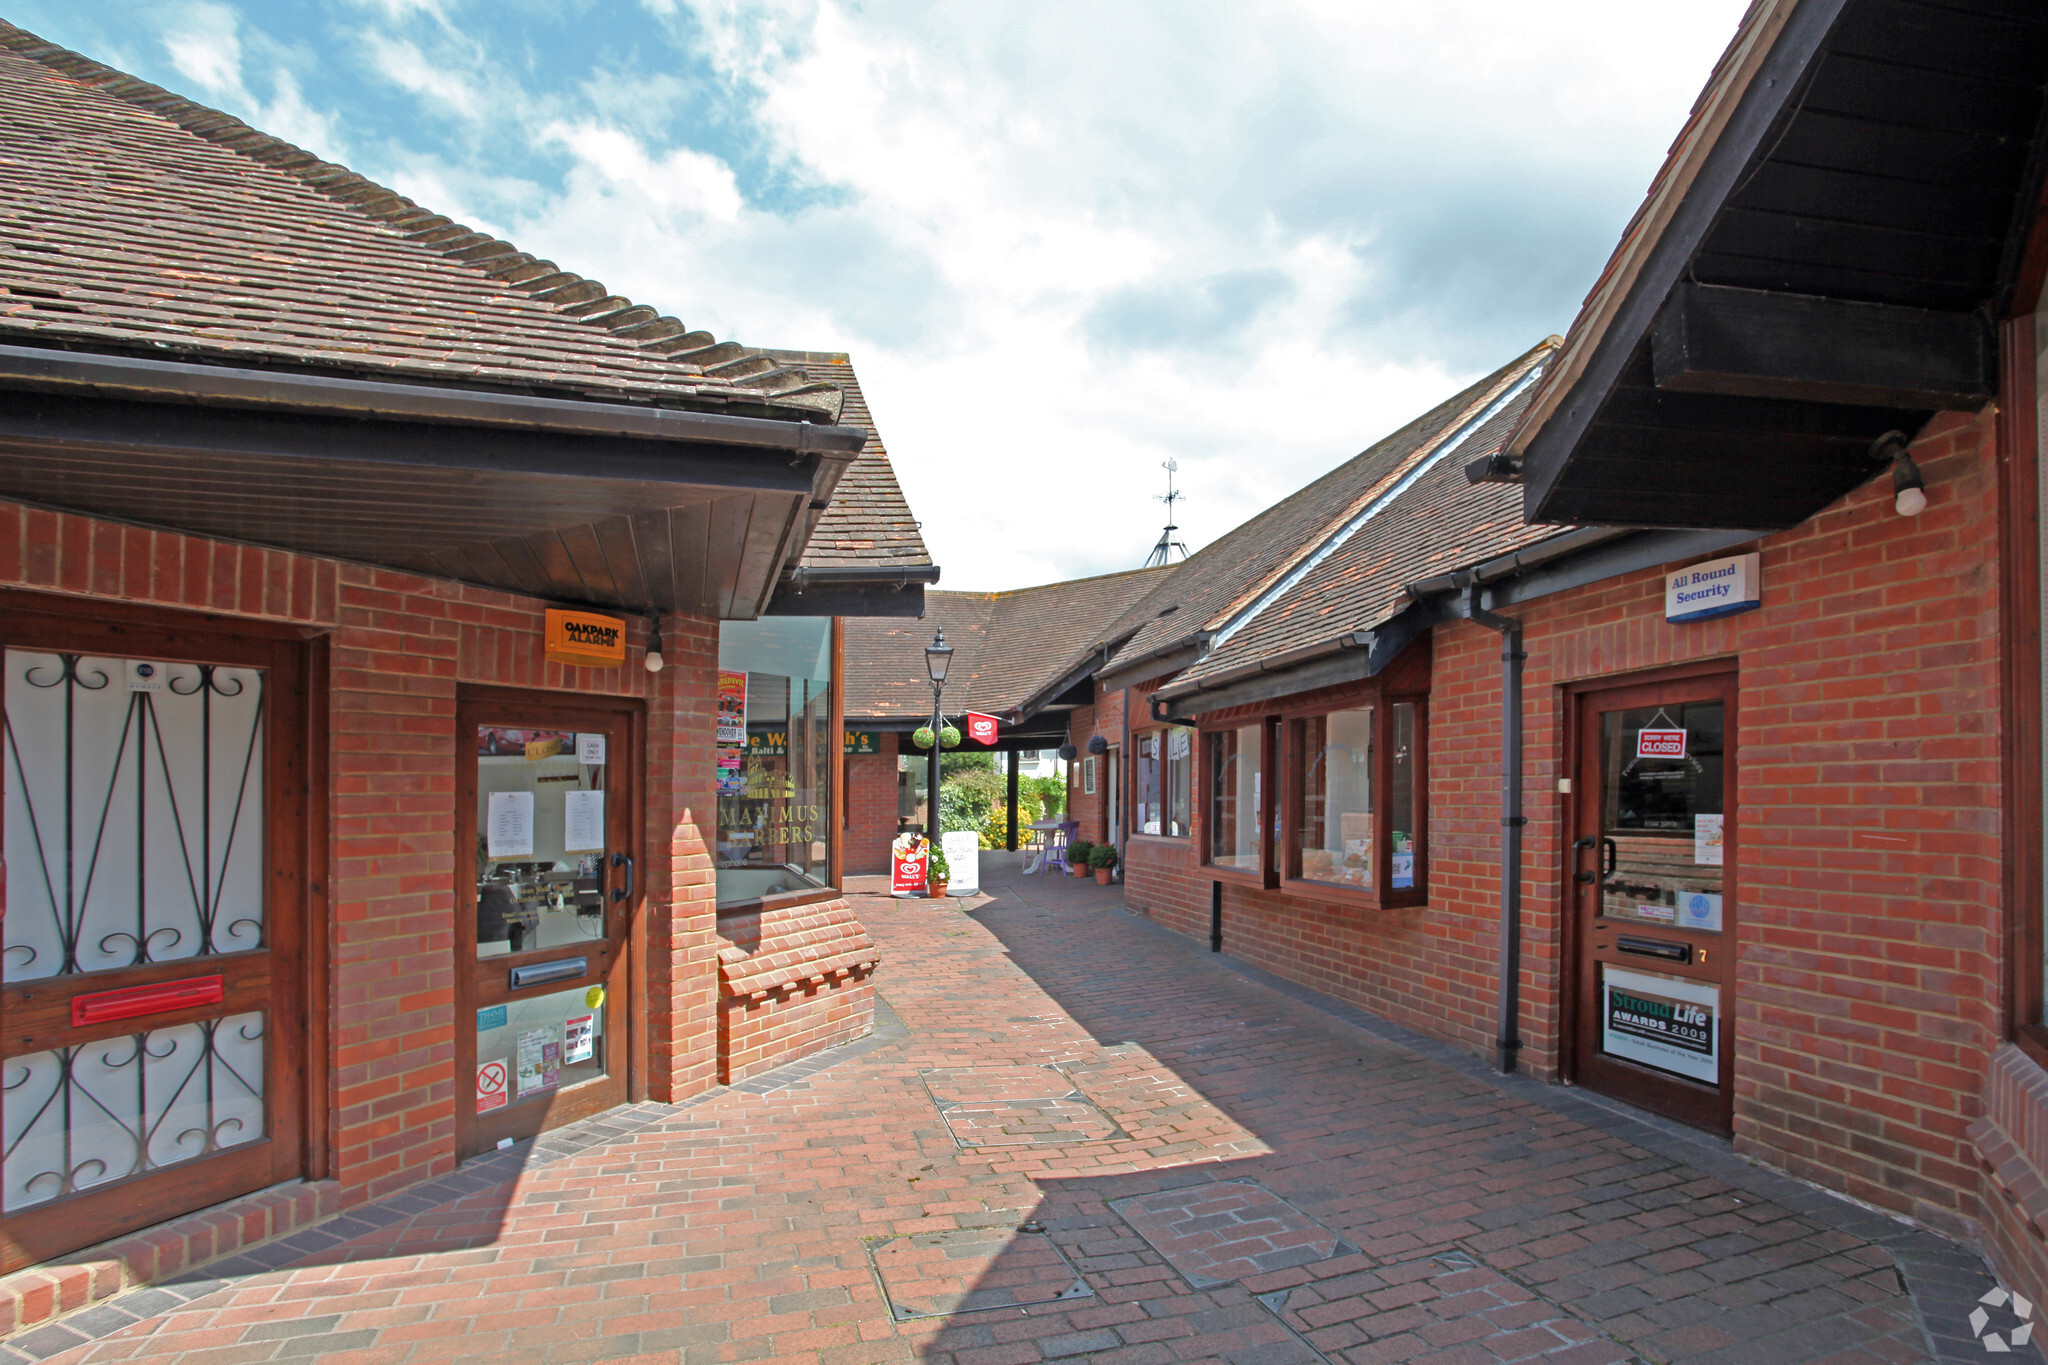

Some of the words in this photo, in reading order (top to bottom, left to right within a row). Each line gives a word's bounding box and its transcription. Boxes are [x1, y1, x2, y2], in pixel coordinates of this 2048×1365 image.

[1672, 575, 1688, 589] All
[1691, 563, 1736, 584] Round
[1676, 583, 1731, 604] Security
[565, 621, 619, 639] OAKPARK
[568, 630, 615, 647] ALARMS
[752, 747, 774, 755] Balti
[776, 747, 785, 755] &
[1641, 742, 1681, 753] CLOSED
[719, 805, 818, 826] MAXIMUS
[726, 825, 814, 848] BARBERS
[1699, 949, 1707, 962] 7
[1613, 990, 1671, 1018] Stroud
[1673, 1002, 1707, 1027] Life
[1612, 1010, 1667, 1030] AWARDS
[1671, 1024, 1707, 1040] 2009
[1632, 1038, 1646, 1046] Small
[1647, 1042, 1669, 1053] Business
